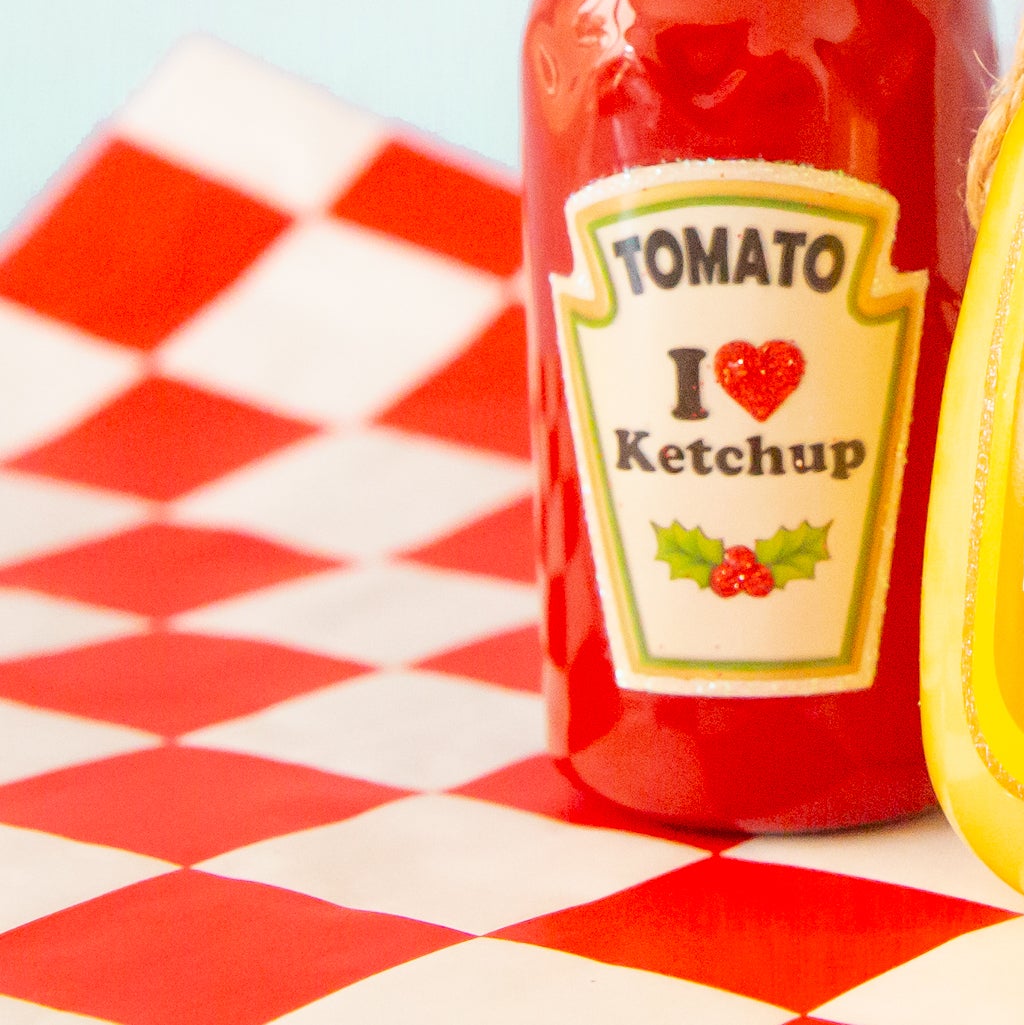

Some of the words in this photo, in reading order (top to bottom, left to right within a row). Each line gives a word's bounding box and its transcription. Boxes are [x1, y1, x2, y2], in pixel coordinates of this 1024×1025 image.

[613, 226, 846, 295] TOMATO
[667, 347, 708, 421] I
[615, 427, 867, 479] Ketchup
